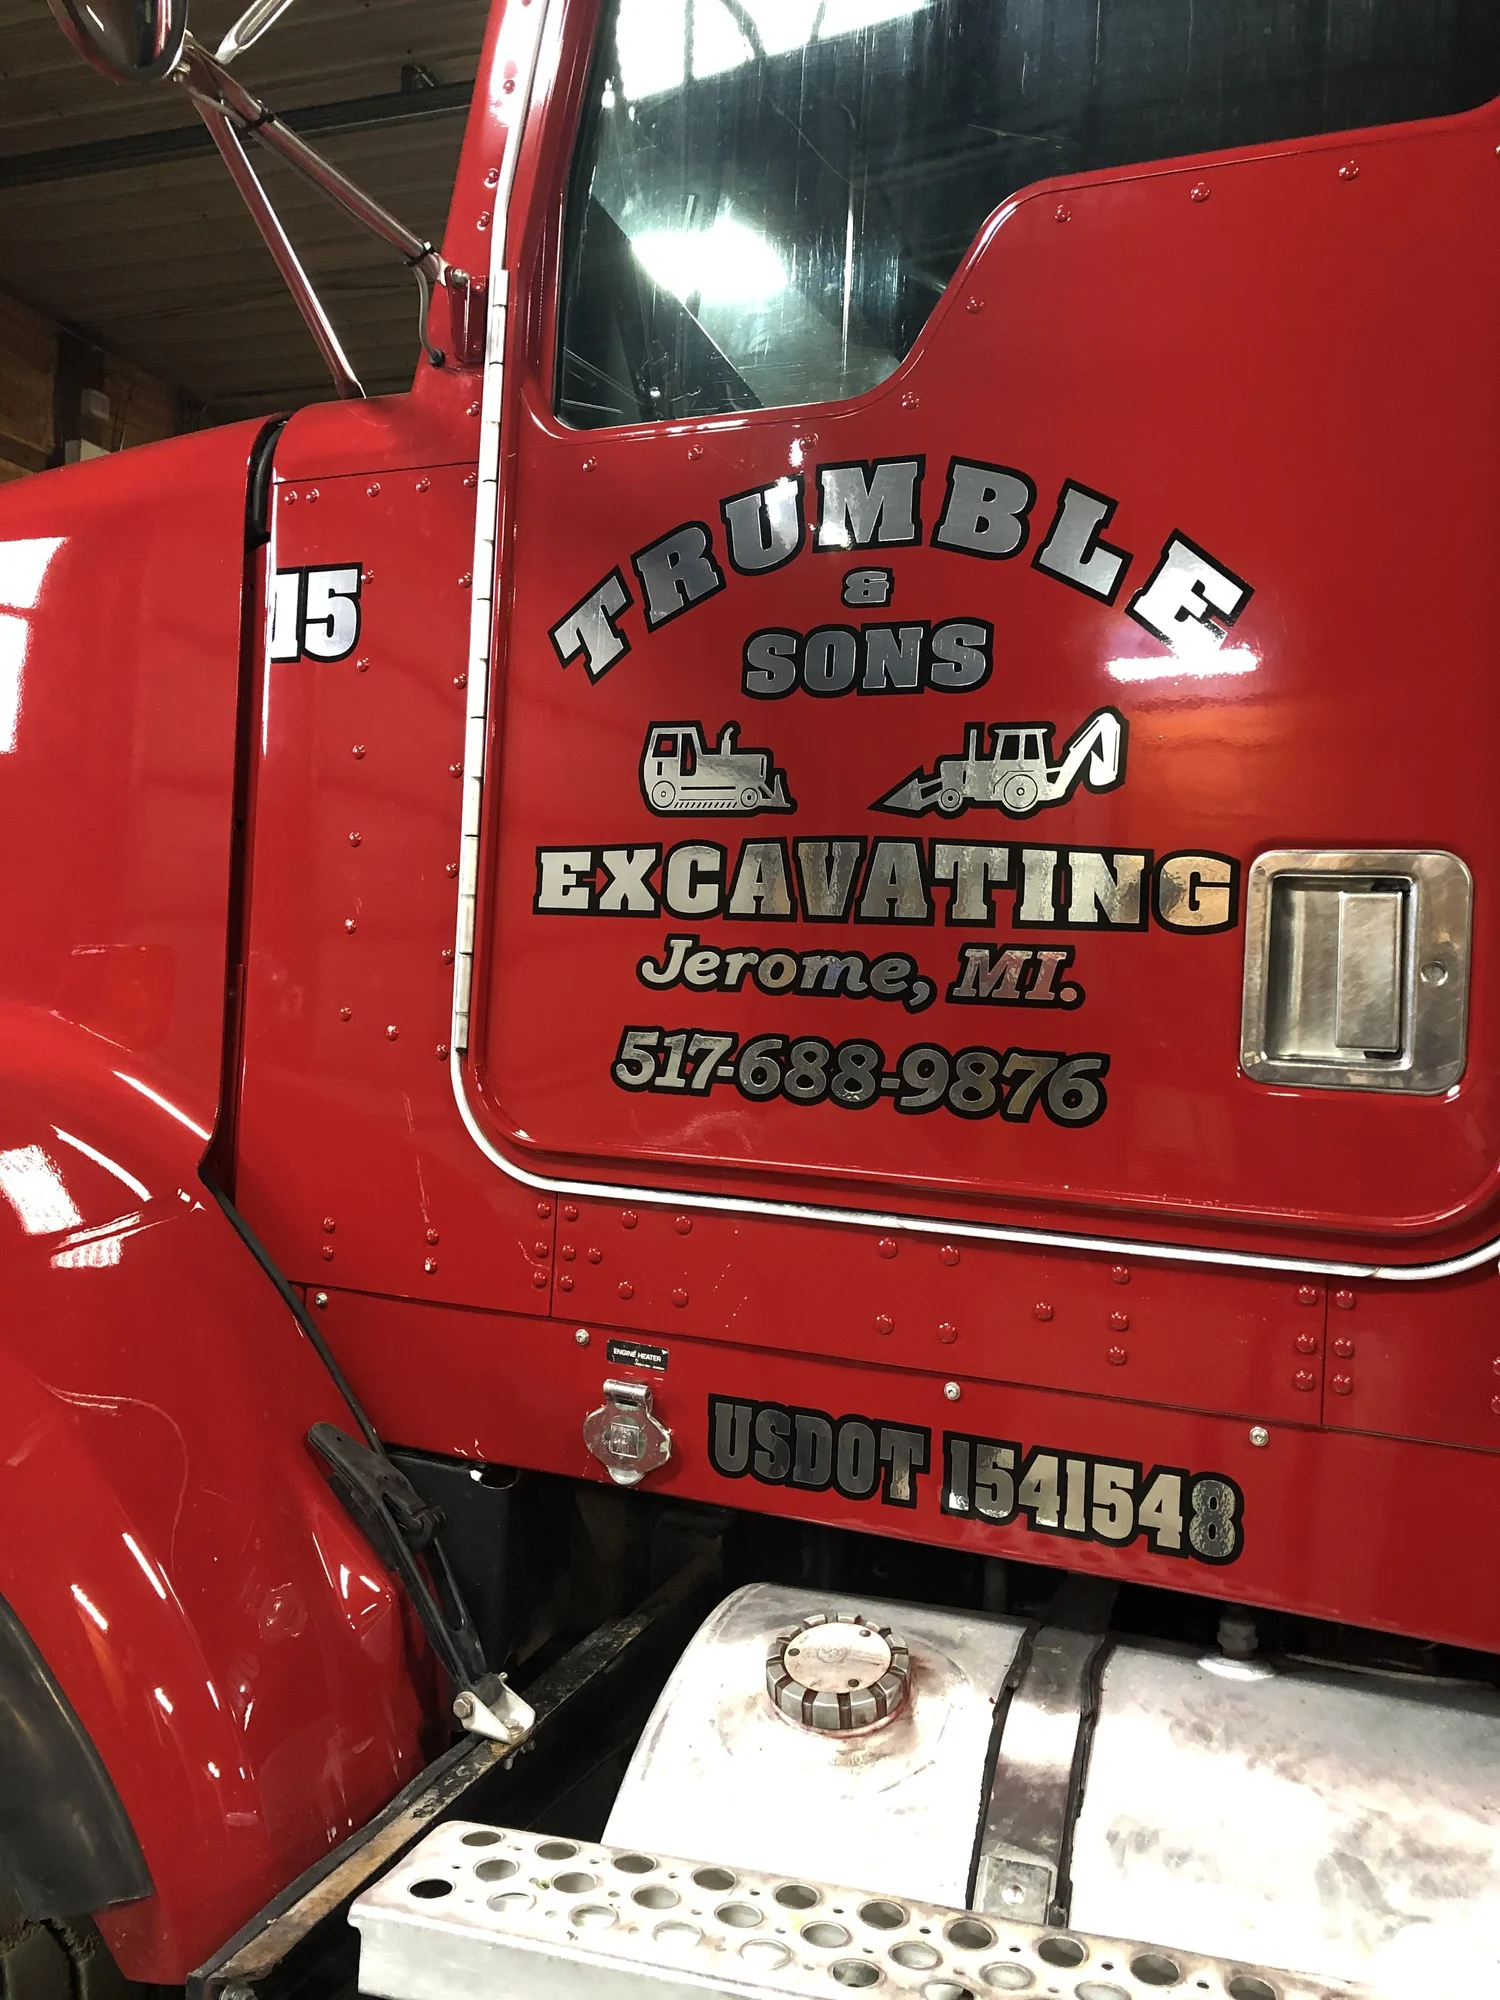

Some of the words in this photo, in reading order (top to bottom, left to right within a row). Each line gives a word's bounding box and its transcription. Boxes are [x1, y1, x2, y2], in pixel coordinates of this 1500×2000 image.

[551, 455, 1254, 684] TRUMBLE
[843, 568, 893, 607] &
[742, 620, 994, 699] SONS
[534, 838, 1239, 933] EXCAVATING
[637, 934, 936, 1012] Jerome,
[947, 942, 1085, 1009] MI.
[612, 1026, 1110, 1127] 517-688-9876
[613, 1347, 637, 1358] ENGINE
[637, 1352, 662, 1362] HEATER
[708, 1394, 931, 1508] USDOT
[942, 1431, 1244, 1565] 1541548
